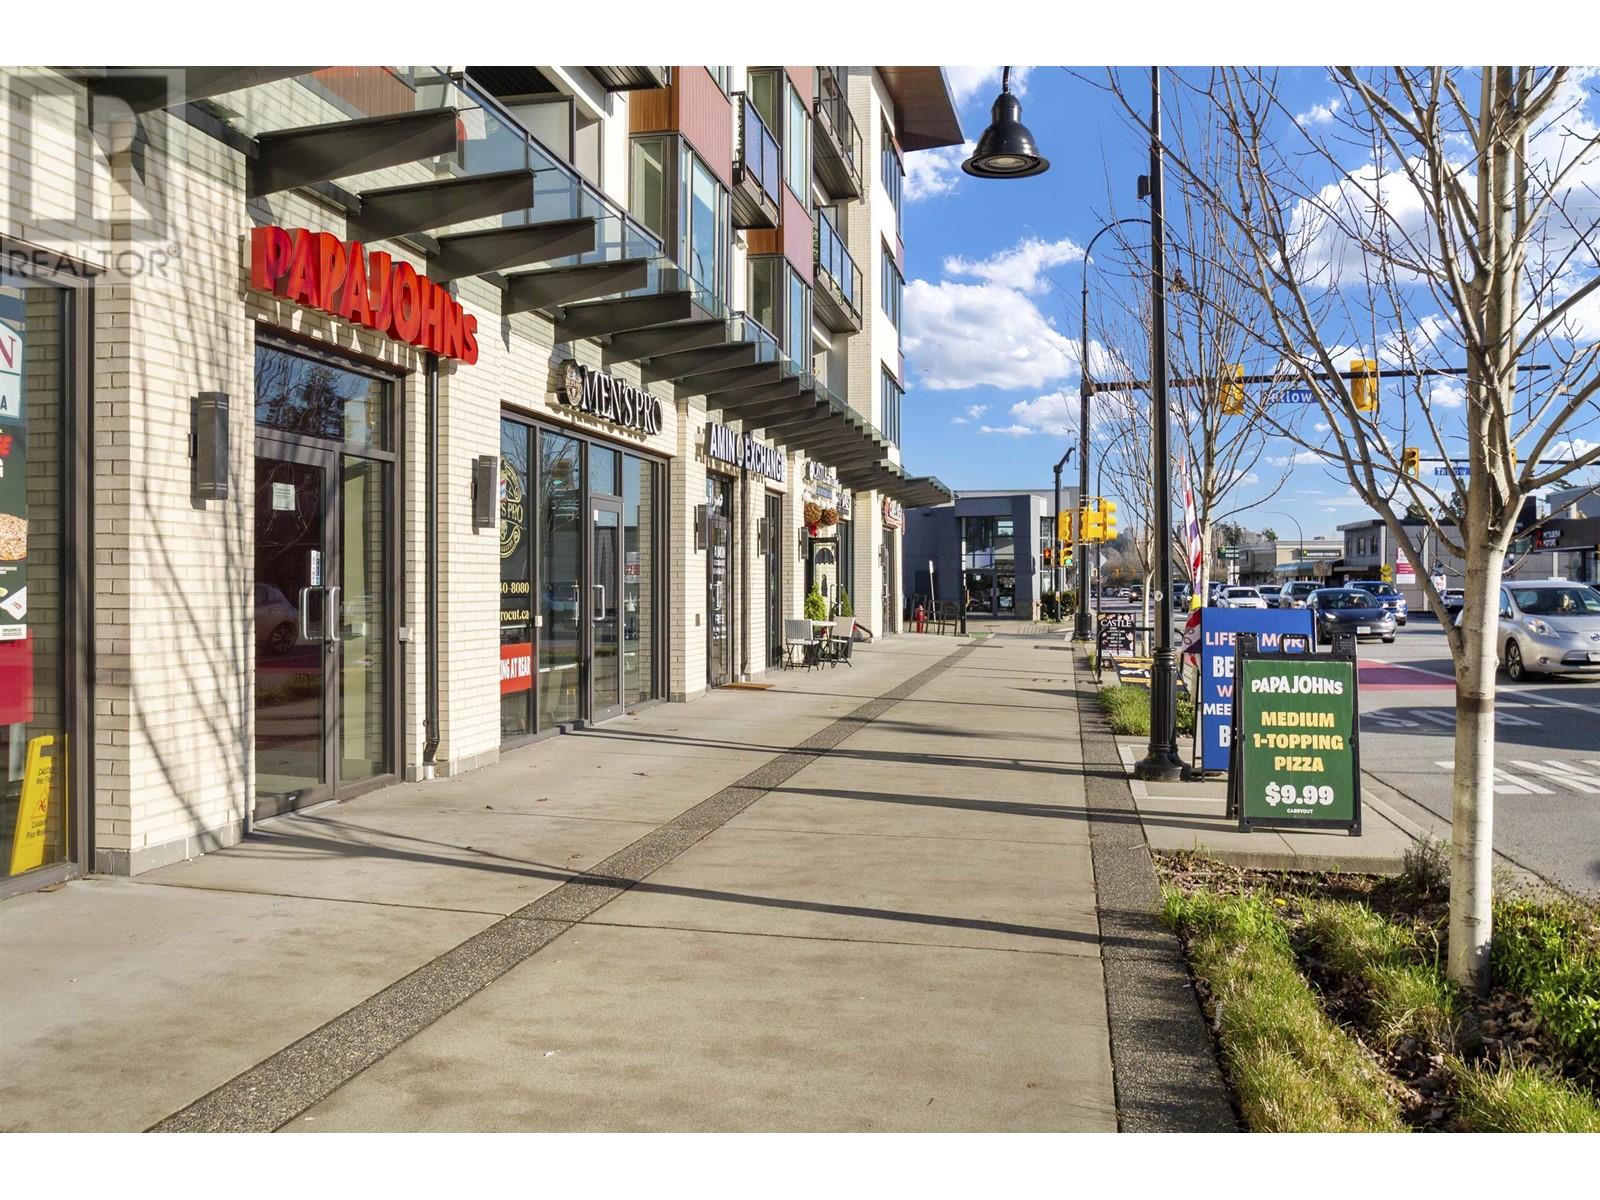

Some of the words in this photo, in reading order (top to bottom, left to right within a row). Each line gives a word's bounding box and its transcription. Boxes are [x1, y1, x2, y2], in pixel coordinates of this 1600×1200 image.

[709, 423, 736, 464] AMIN
[501, 609, 529, 621] rocut.ca
[1100, 619, 1132, 628] CASTLE
[1261, 711, 1335, 728] MEDIUM
[1253, 733, 1344, 750] 1-TOPPING
[1274, 756, 1325, 772] PIZZA
[1265, 781, 1334, 807] $9.99
